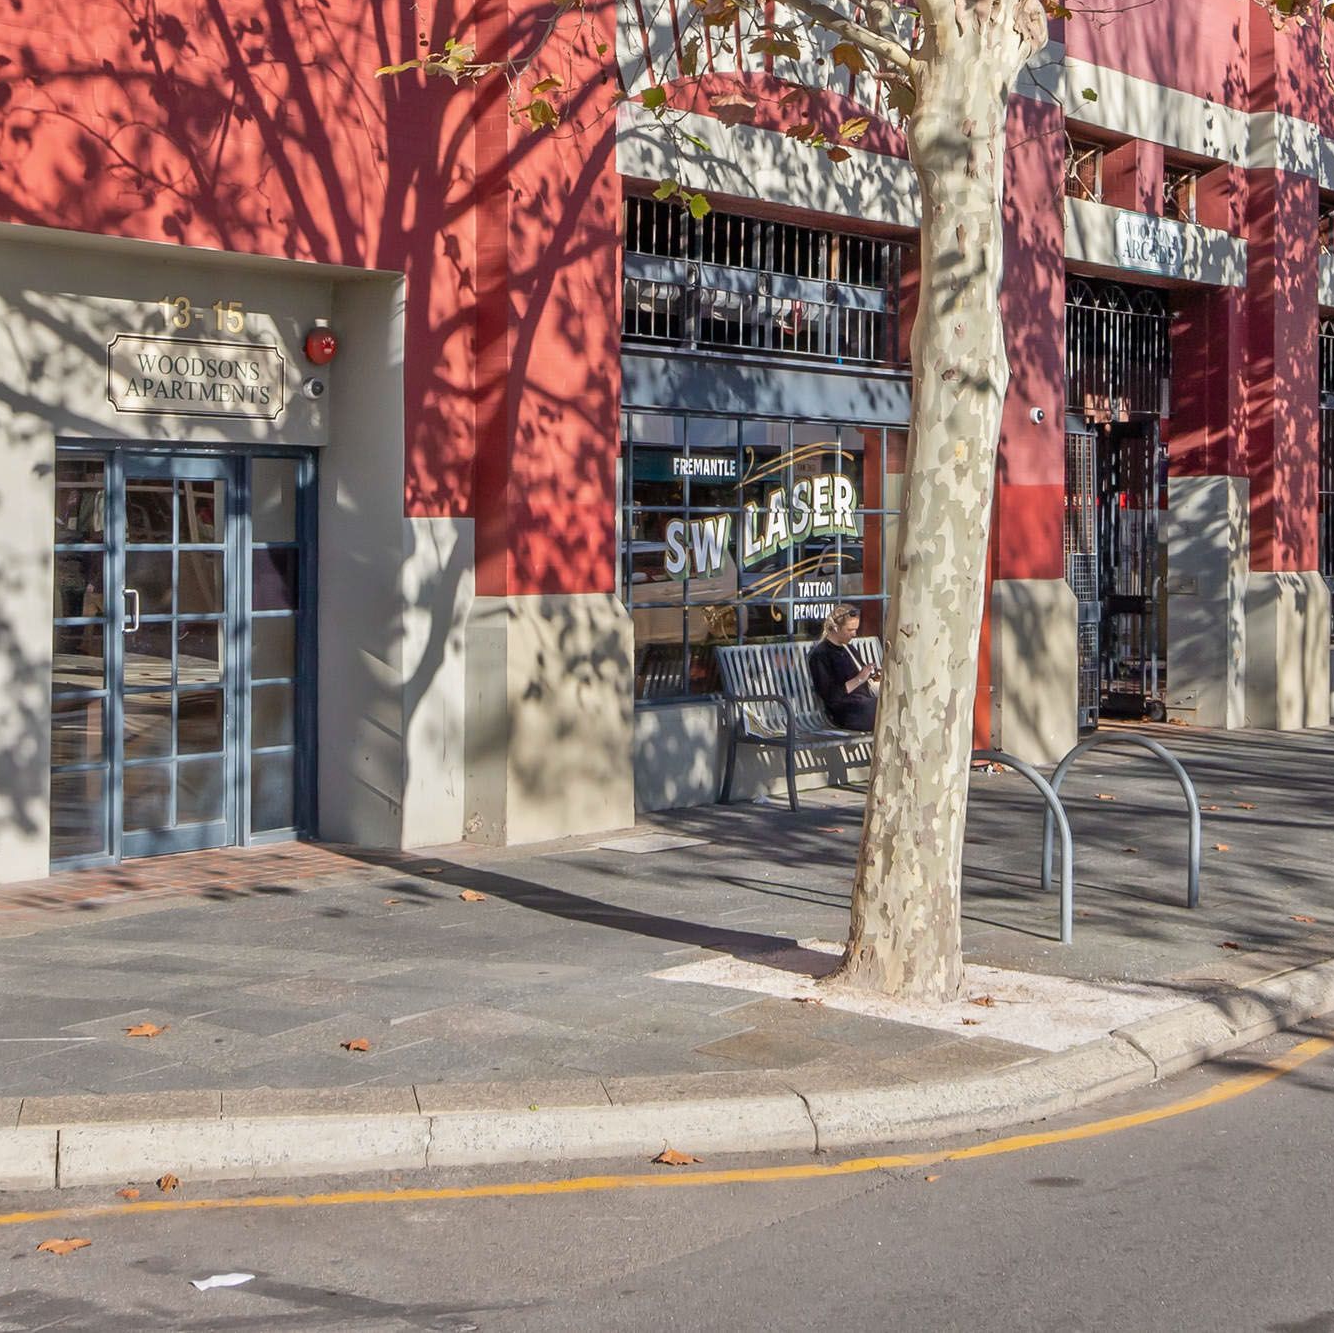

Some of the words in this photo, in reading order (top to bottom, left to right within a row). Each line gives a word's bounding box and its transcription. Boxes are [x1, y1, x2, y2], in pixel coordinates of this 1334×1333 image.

[137, 352, 260, 381] WOODSONS
[125, 377, 271, 405] APARTMENTS
[673, 457, 736, 477] FREMANTLE
[665, 513, 732, 580] SW
[743, 473, 859, 567] LASER
[798, 581, 833, 598] TATTOO
